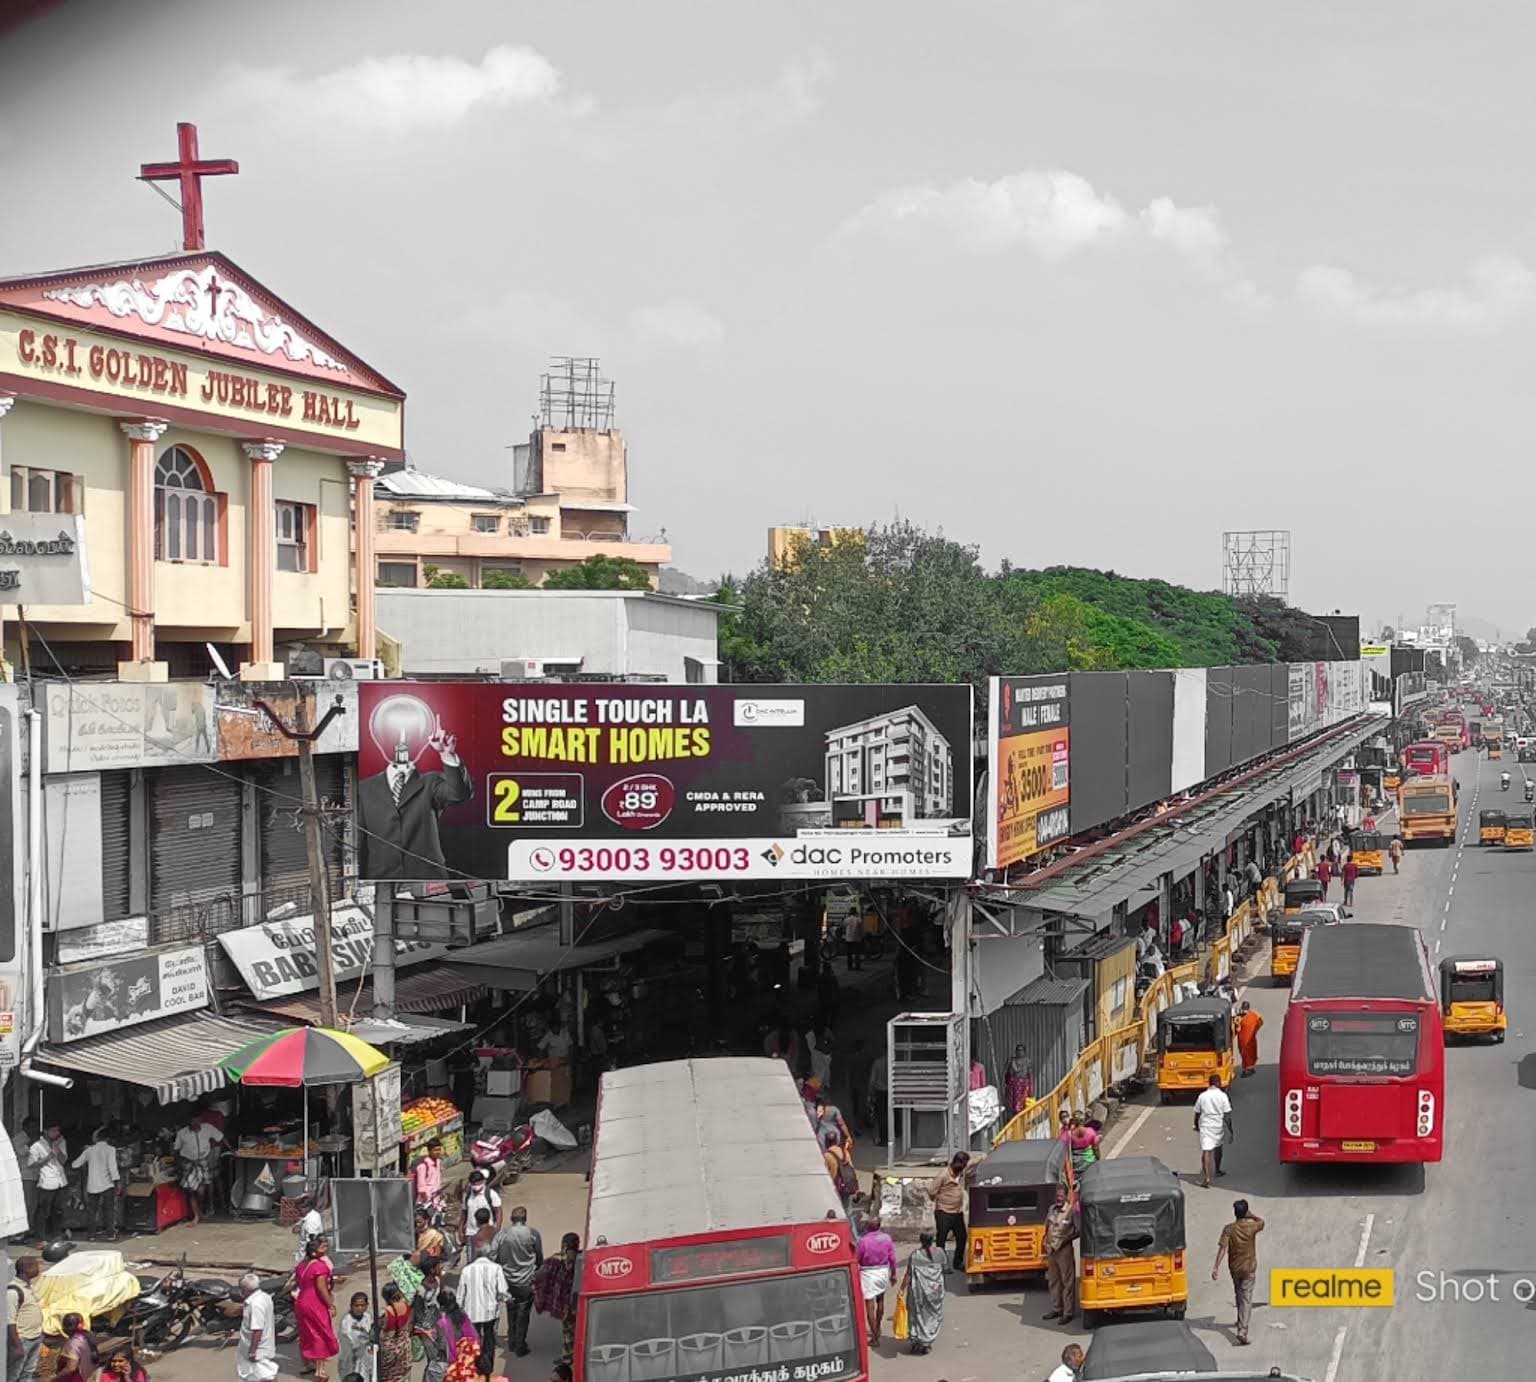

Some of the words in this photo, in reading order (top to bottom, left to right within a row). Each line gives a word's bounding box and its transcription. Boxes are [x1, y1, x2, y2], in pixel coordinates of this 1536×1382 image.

[19, 330, 82, 374] C.S.I.
[89, 346, 188, 394] GOLDEN
[201, 370, 293, 416] JUBILEE
[302, 391, 361, 429] HALL
[502, 698, 588, 723] SINGLE
[595, 699, 673, 723] TOUCH
[680, 699, 709, 723] LA
[501, 726, 602, 763] SMART
[609, 727, 711, 763] HOMES
[494, 779, 520, 821] 2
[544, 789, 566, 797] FROM
[686, 792, 719, 800] CMDA
[722, 792, 730, 800] &
[734, 792, 765, 800] RERA
[522, 799, 549, 809] CAMP
[551, 799, 577, 809] ROAD
[695, 803, 757, 811] APPROVED
[522, 811, 568, 821] JUNCTION
[559, 848, 650, 871] 93003
[659, 848, 750, 871] 93003
[791, 845, 842, 864] dac
[851, 848, 952, 864] Promoters
[814, 868, 852, 876] HOMES
[252, 950, 321, 987] BAB
[171, 982, 196, 995] DAVID
[164, 996, 187, 1008] COOL
[188, 991, 205, 1003] BAR
[1399, 1020, 1417, 1031] MTC
[810, 1234, 839, 1251] MTC
[601, 1259, 630, 1276] MTC
[793, 1356, 844, 1381] கழகம்
